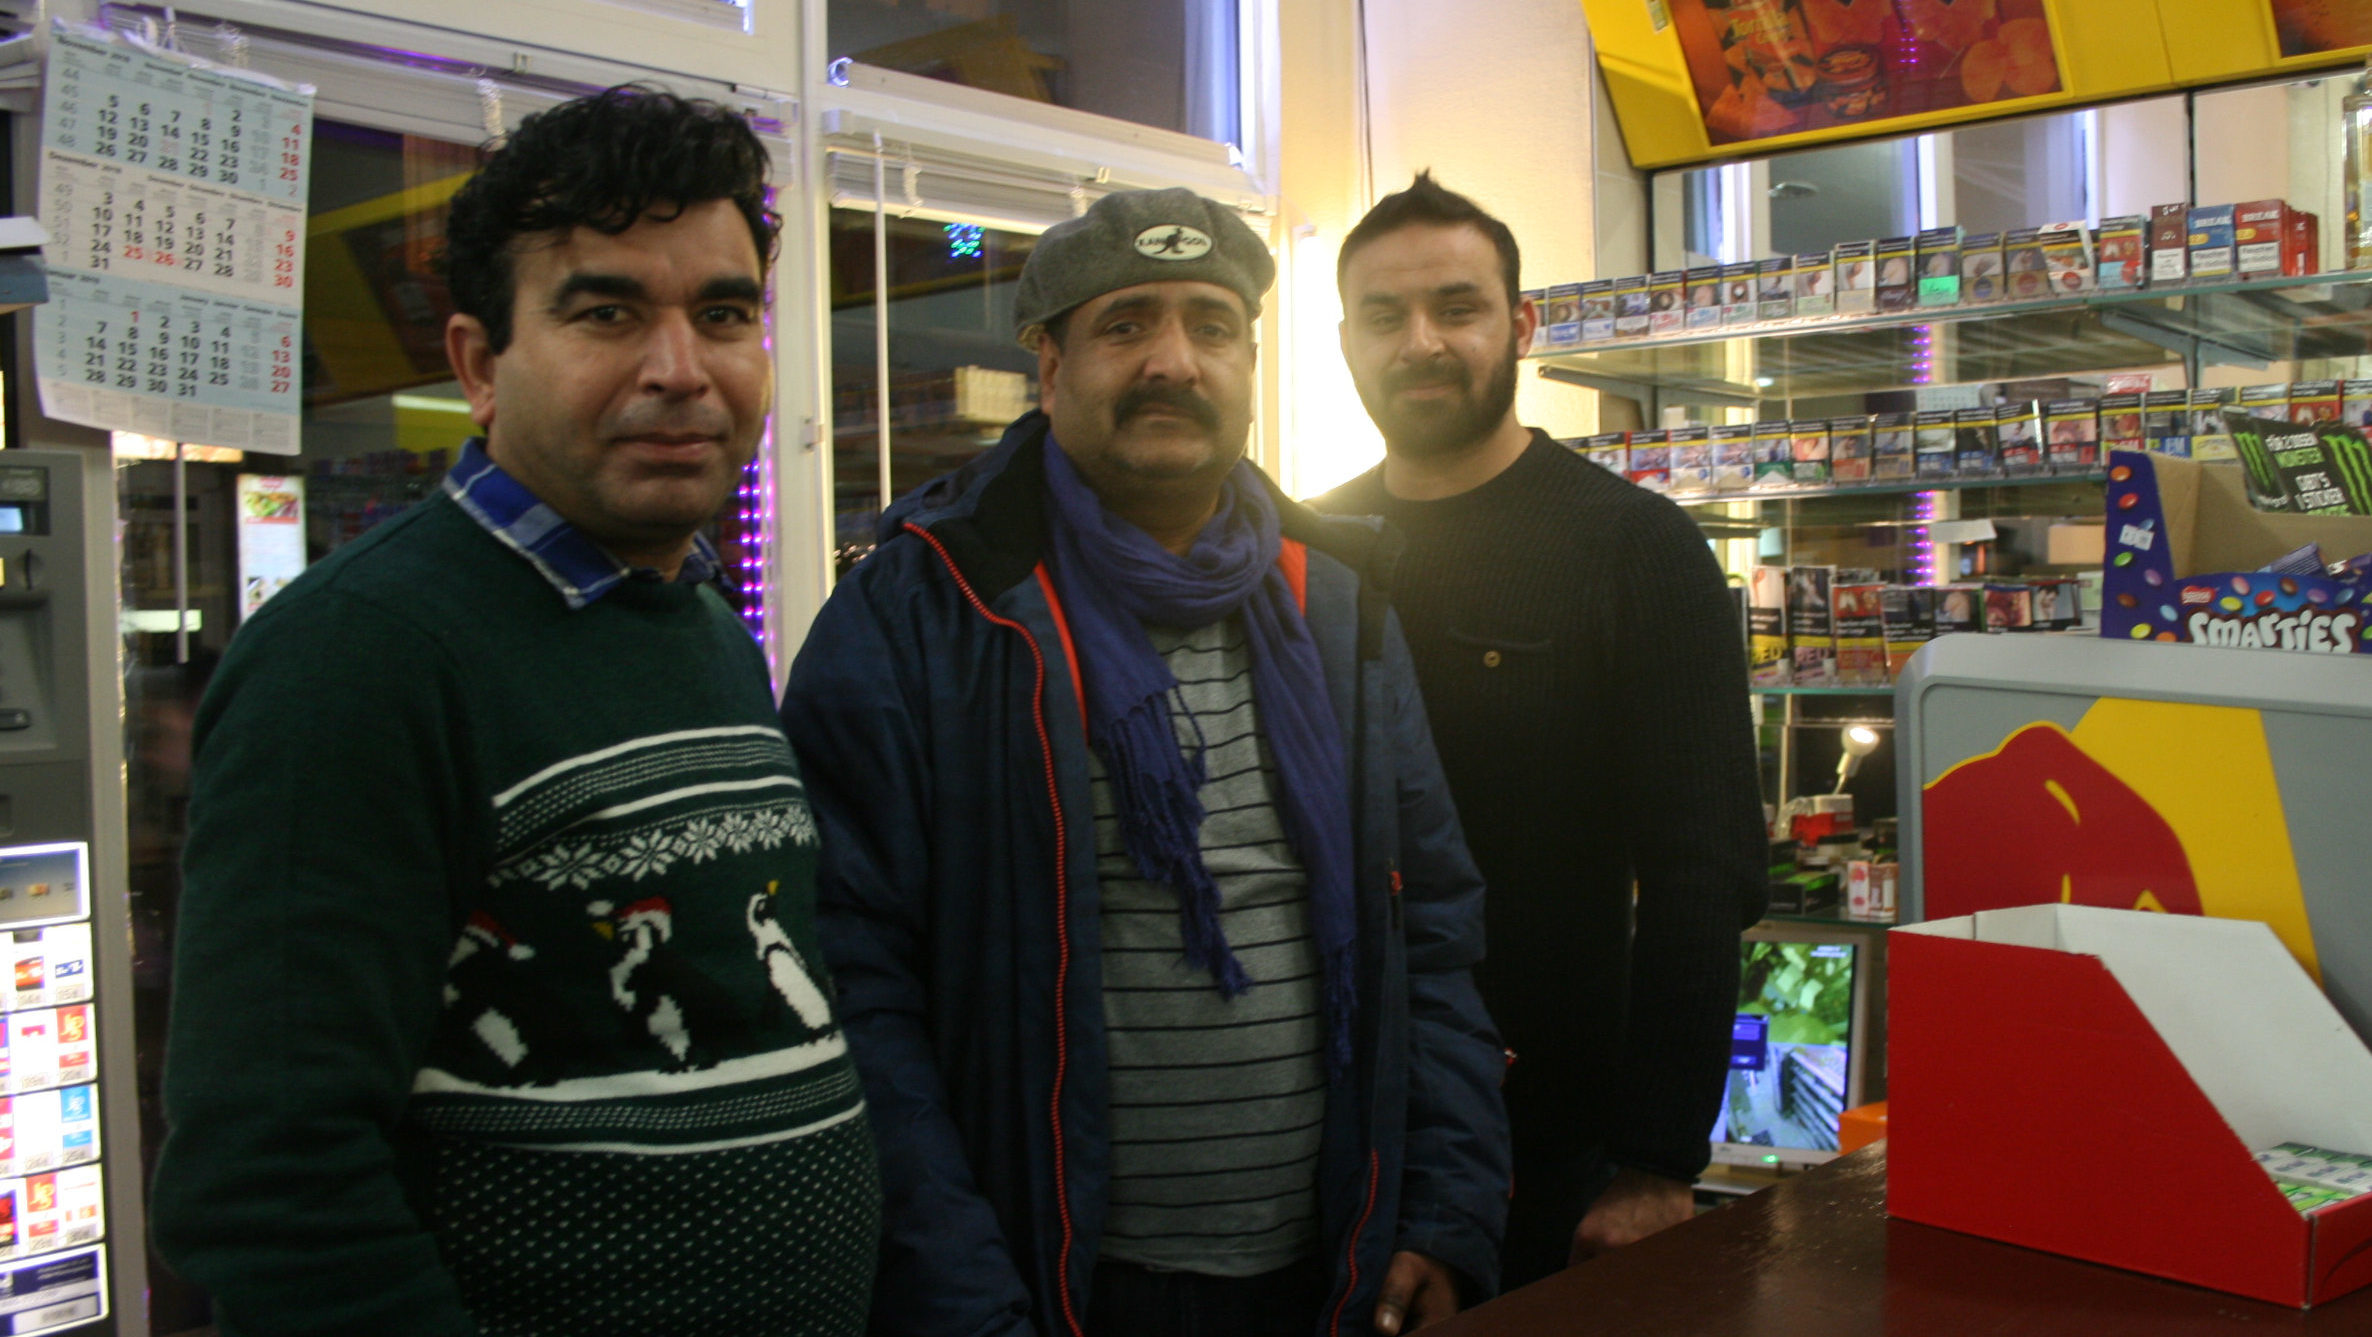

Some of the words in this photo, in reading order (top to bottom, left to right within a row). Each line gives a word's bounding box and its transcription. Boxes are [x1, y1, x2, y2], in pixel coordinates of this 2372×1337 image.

[99, 109, 118, 125] 12
[131, 117, 149, 131] 13
[160, 124, 180, 138] 14
[191, 132, 210, 146] 15
[222, 139, 240, 153] 16
[281, 152, 299, 166] 18
[109, 95, 119, 108] 5
[139, 103, 151, 116] 6
[170, 110, 181, 123] 7
[201, 118, 211, 131] 8
[231, 125, 241, 138] 9
[282, 137, 299, 151] 11
[231, 109, 242, 122] 2
[291, 124, 302, 135] 4
[95, 141, 116, 157] 26
[128, 148, 147, 163] 27
[159, 156, 178, 171] 28
[189, 163, 208, 178] 29
[219, 169, 239, 184] 30
[98, 125, 117, 140] 19
[128, 132, 148, 148] 20
[190, 147, 208, 161] 22
[220, 154, 239, 169] 23
[280, 168, 298, 181] 25
[93, 207, 112, 222] 10
[125, 213, 143, 227] 11
[156, 220, 174, 234] 12
[186, 226, 205, 240] 13
[216, 232, 234, 246] 14
[276, 243, 294, 258] 16
[104, 192, 113, 205] 3
[134, 200, 144, 212] 4
[166, 205, 175, 218] 5
[196, 212, 206, 225] 6
[226, 218, 236, 231] 7
[285, 229, 296, 242] 9
[91, 255, 109, 270] 31
[92, 239, 111, 254] 24
[124, 245, 144, 260] 25
[155, 251, 175, 266] 26
[184, 257, 203, 272] 27
[214, 263, 234, 277] 28
[274, 274, 293, 288] 30
[93, 223, 111, 237] 17
[124, 230, 143, 244] 18
[156, 236, 174, 250] 19
[186, 241, 204, 256] 20
[215, 247, 233, 261] 21
[275, 258, 293, 273] 23
[97, 321, 108, 334] 7
[128, 326, 139, 340] 8
[159, 331, 170, 345] 9
[181, 335, 200, 350] 10
[211, 340, 230, 354] 11
[272, 349, 291, 363] 13
[130, 310, 140, 323] 1
[160, 315, 171, 329] 2
[191, 321, 201, 334] 3
[221, 326, 231, 338] 4
[281, 335, 292, 348] 6
[85, 351, 105, 367] 21
[117, 356, 137, 373] 22
[148, 361, 168, 377] 23
[178, 366, 198, 381] 24
[209, 371, 230, 386] 25
[271, 380, 291, 394] 27
[87, 336, 107, 351] 14
[118, 341, 137, 356] 15
[149, 346, 169, 361] 16
[180, 351, 199, 366] 17
[210, 356, 230, 370] 18
[271, 364, 292, 379] 20
[86, 367, 107, 383] 28
[116, 373, 137, 388] 29
[147, 378, 168, 394] 30
[178, 382, 197, 398] 31
